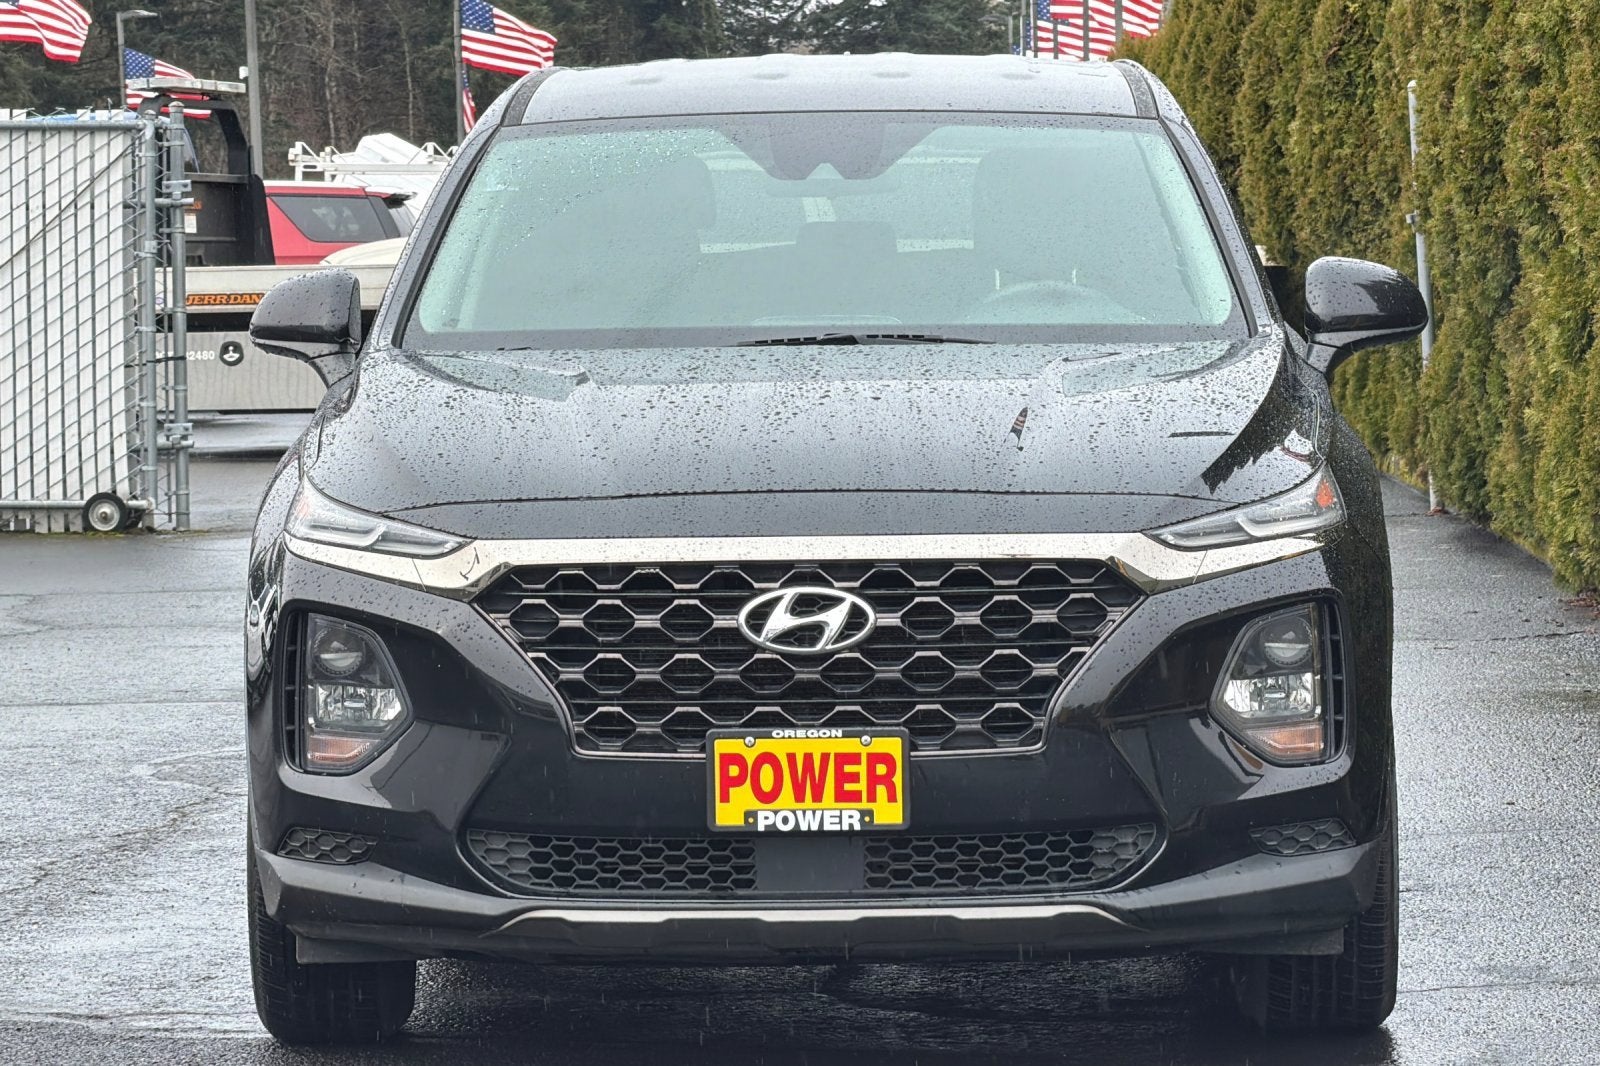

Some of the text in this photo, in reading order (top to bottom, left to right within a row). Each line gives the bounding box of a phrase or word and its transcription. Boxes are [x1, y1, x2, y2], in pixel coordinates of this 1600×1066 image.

[772, 729, 842, 738] OREGON
[719, 752, 898, 804] POWER
[757, 810, 861, 831] POWER
